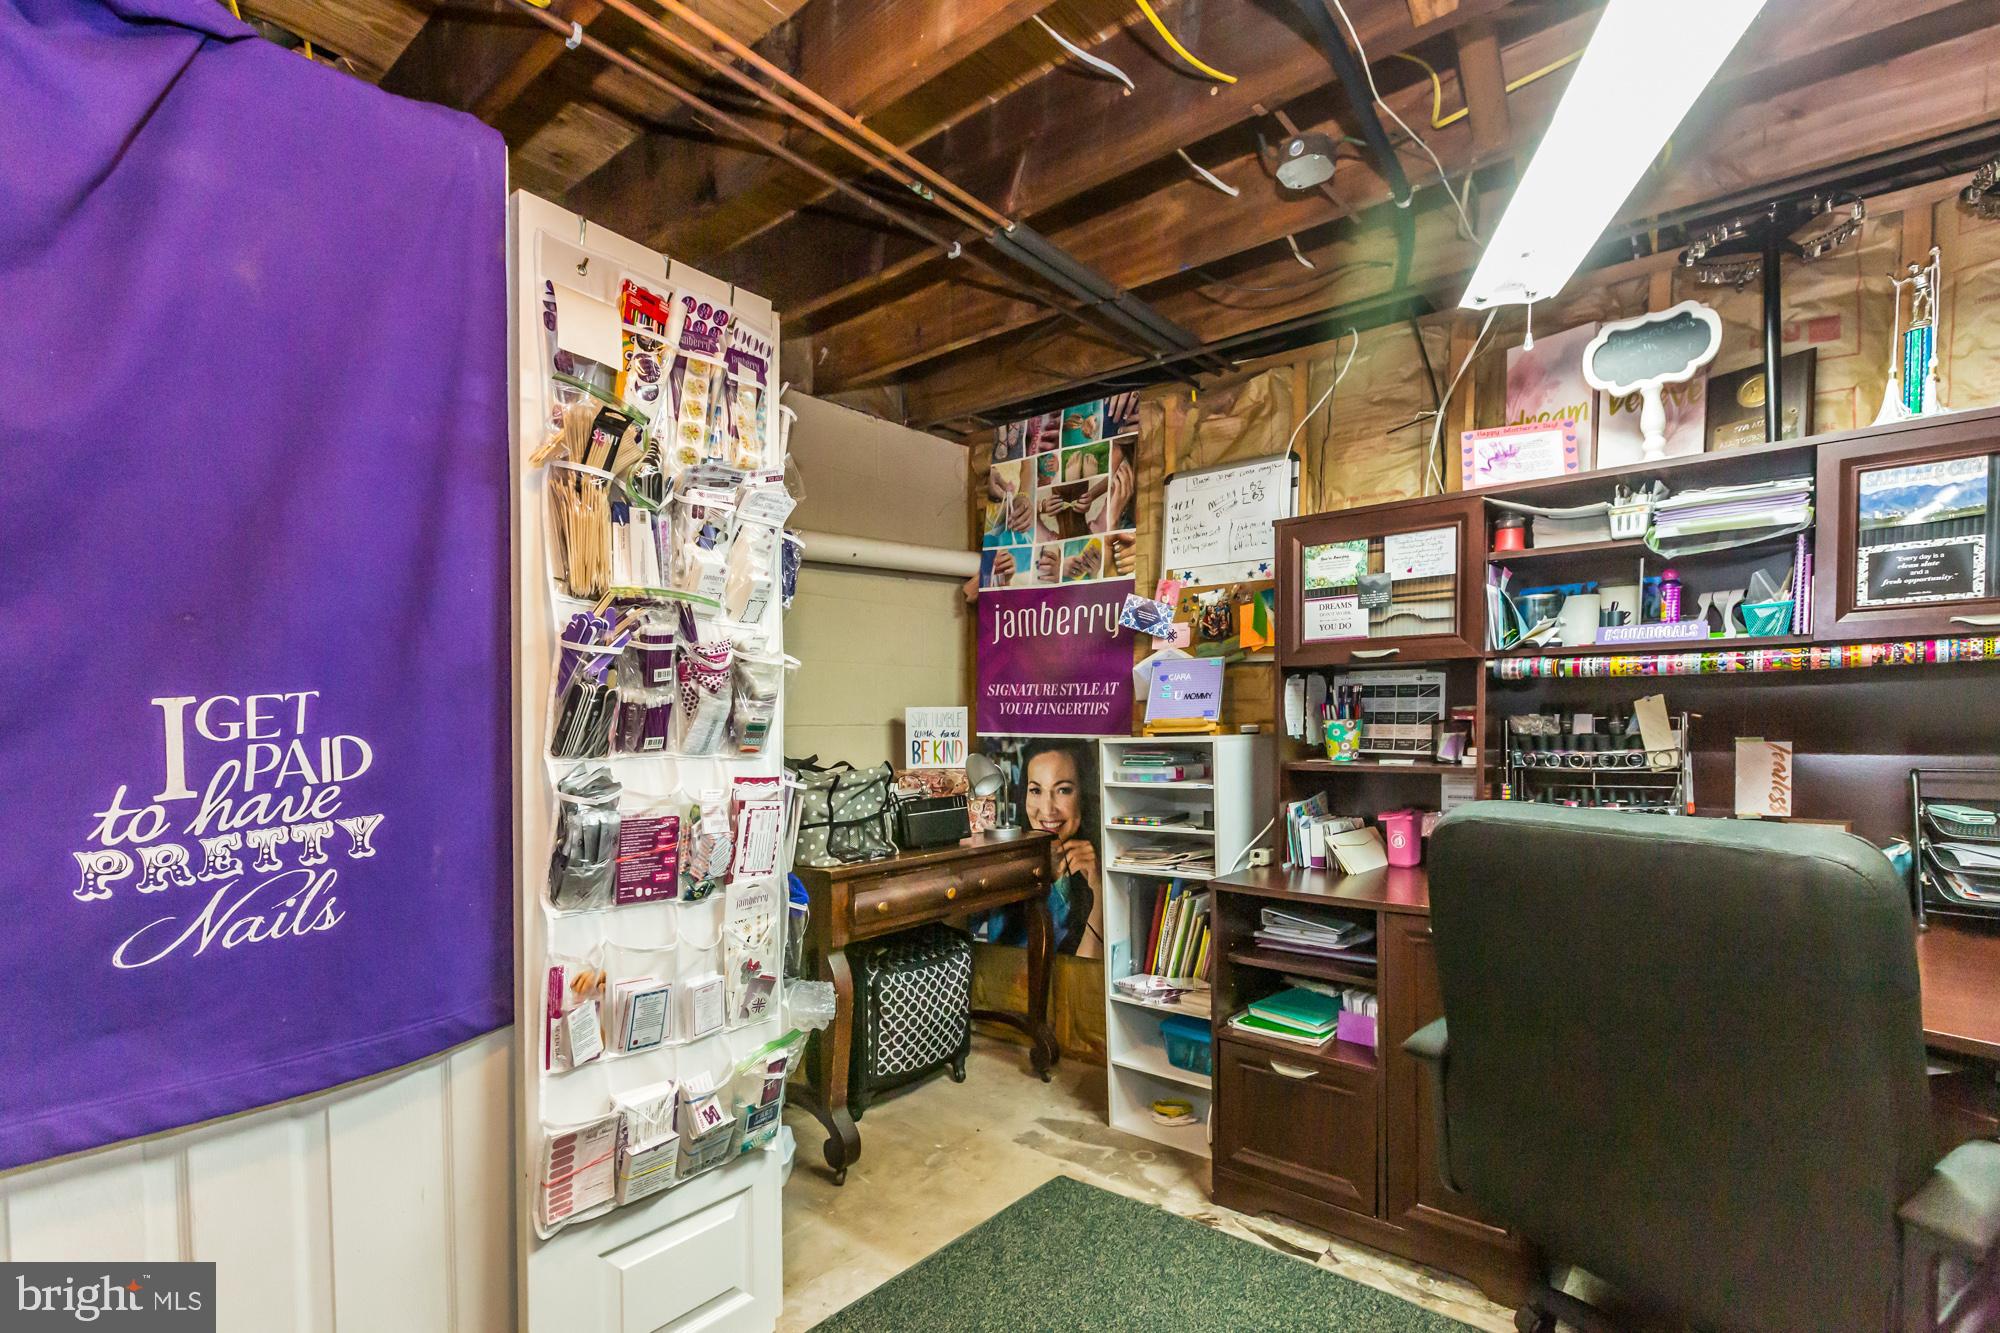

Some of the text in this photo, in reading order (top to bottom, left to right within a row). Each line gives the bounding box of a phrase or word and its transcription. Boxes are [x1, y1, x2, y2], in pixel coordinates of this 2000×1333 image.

[1919, 553, 1931, 561] day
[1881, 577, 1902, 587] fresh
[1319, 601, 1353, 611] DREAMS
[992, 601, 1120, 645] jamberry
[1319, 622, 1352, 632] YOU DO
[987, 682, 1120, 697] SIGNATURE STYLE AT
[1183, 692, 1213, 701] MOMMY
[999, 702, 1110, 716] YOUR FINGERTIPS
[151, 690, 320, 802] I GET
[911, 739, 963, 765] BE KIND
[244, 735, 373, 792] PAID
[87, 759, 342, 847] to have
[72, 813, 385, 902] PRETTY
[112, 868, 347, 969] Nails
